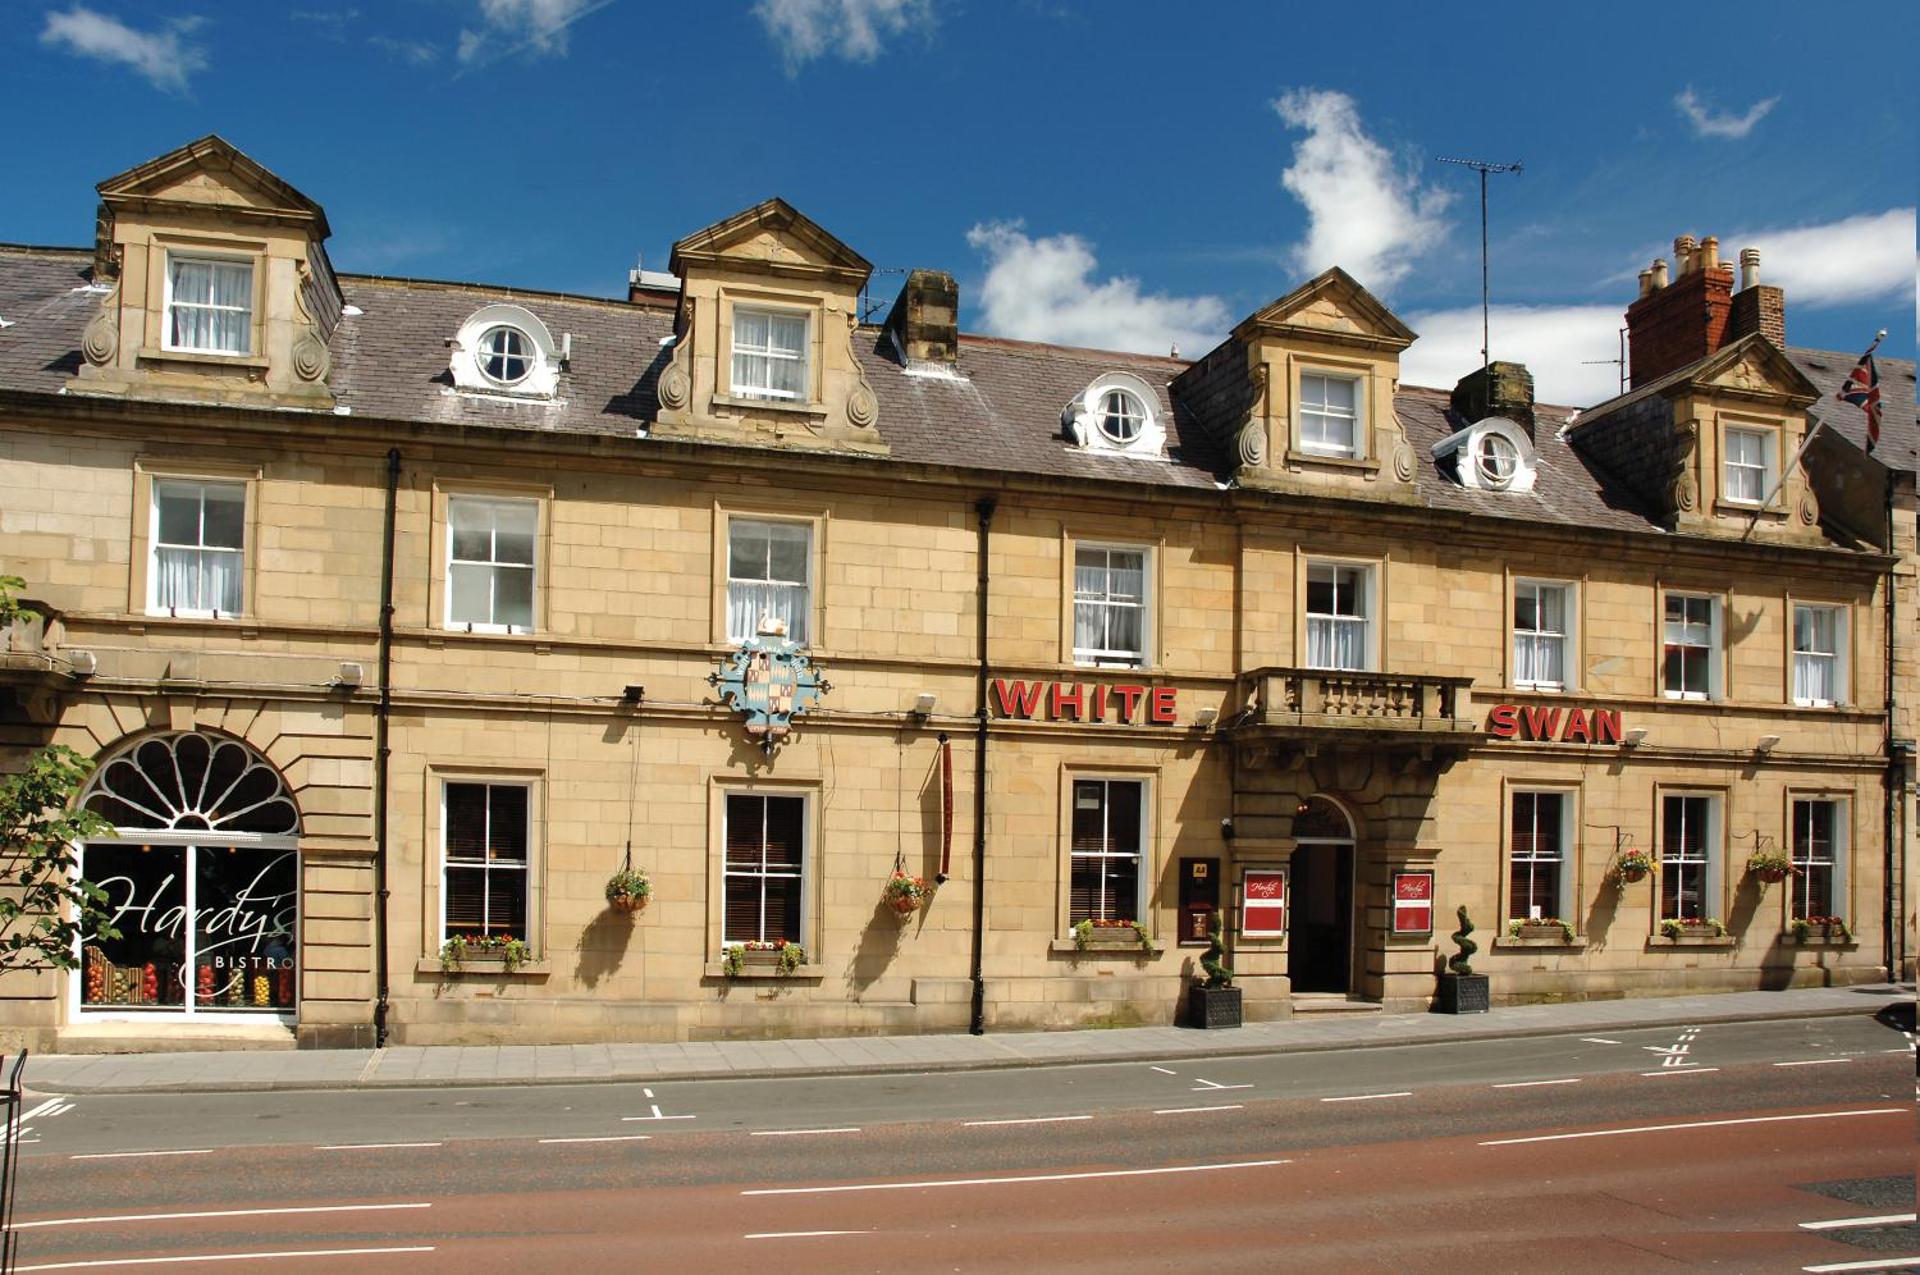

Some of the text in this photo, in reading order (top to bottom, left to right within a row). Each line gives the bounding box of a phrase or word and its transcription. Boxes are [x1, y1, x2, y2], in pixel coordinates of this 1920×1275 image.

[995, 678, 1622, 743] WHITE SWAN
[82, 852, 297, 997] Hardy's
[215, 955, 294, 970] BISTRO
